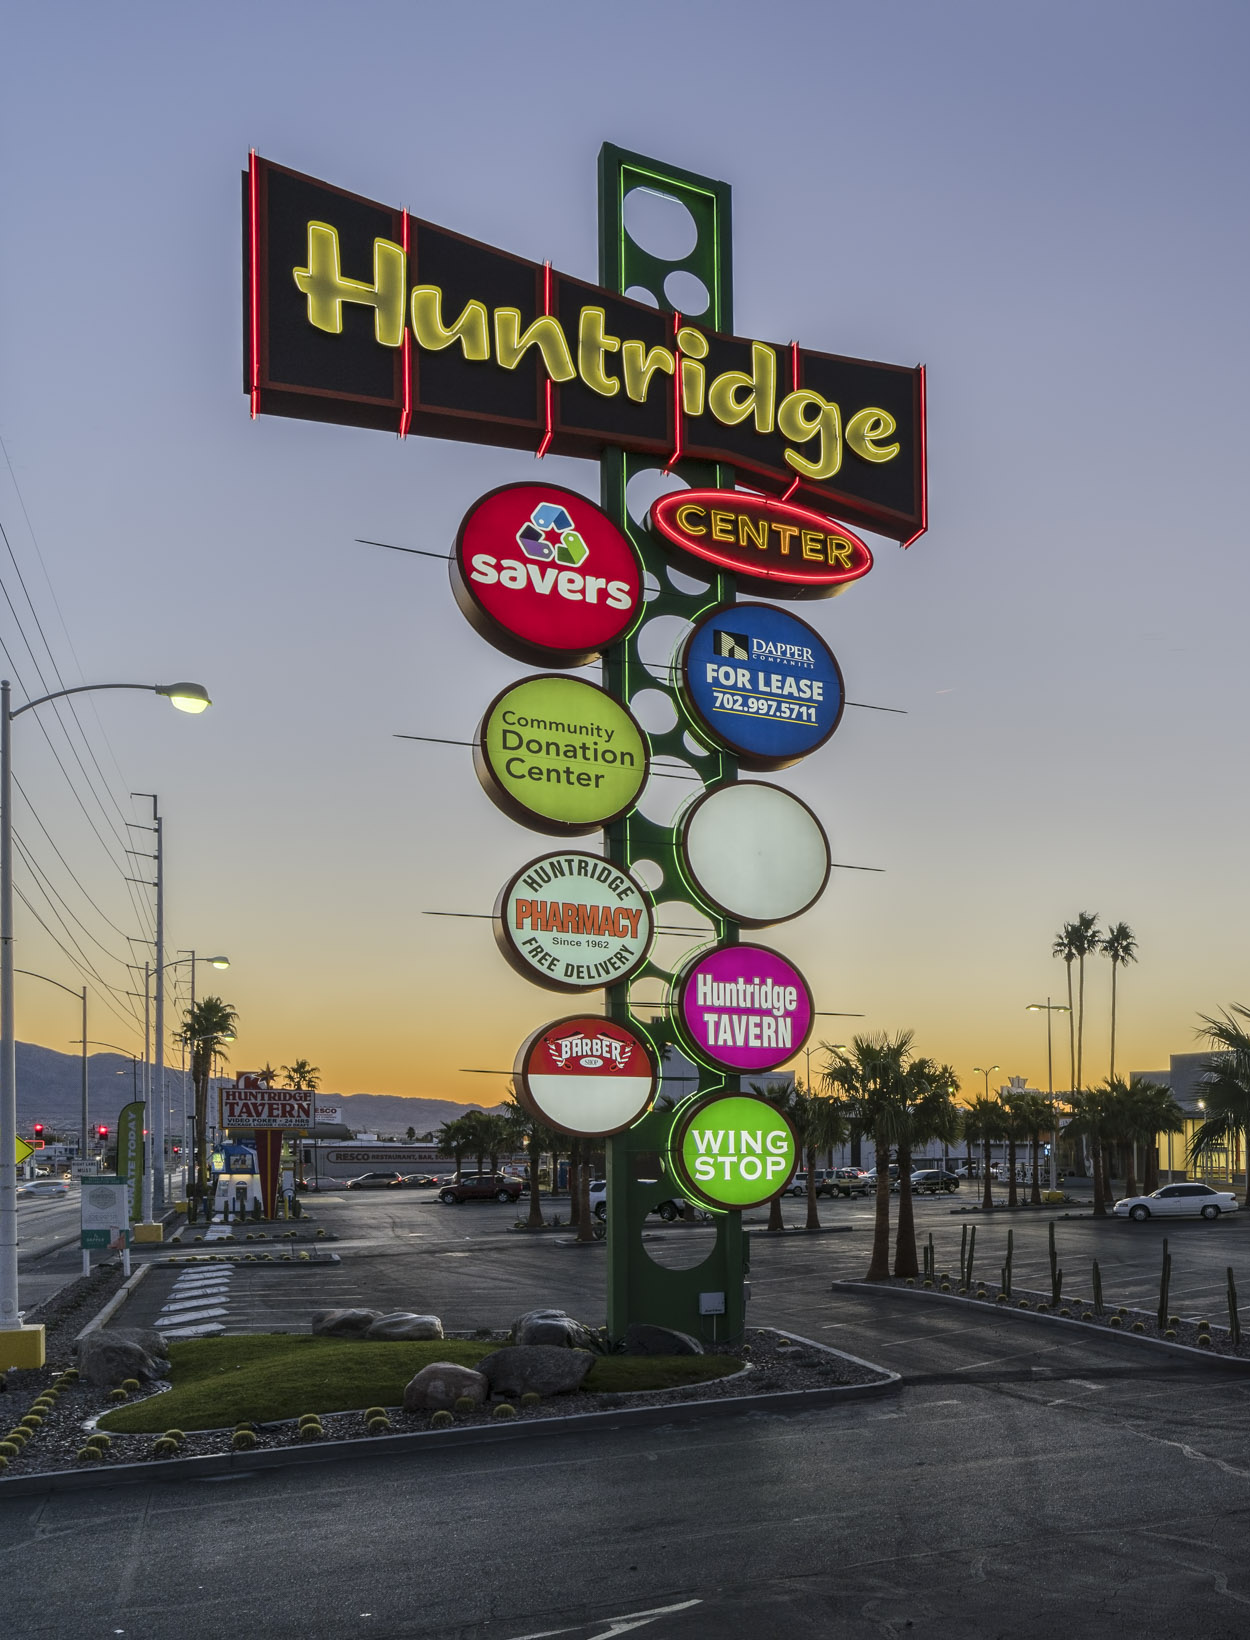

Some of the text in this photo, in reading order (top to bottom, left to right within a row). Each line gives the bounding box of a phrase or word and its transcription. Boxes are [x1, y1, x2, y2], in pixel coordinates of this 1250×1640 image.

[292, 220, 900, 480] Huntridge
[676, 504, 853, 569] CENTER
[470, 553, 632, 610] savers
[752, 638, 815, 662] DAPPER
[752, 654, 814, 669] COMPANIES
[706, 662, 824, 701] FOR LEASE
[713, 691, 816, 722] 702.997.5711
[502, 710, 615, 742] Community
[502, 729, 635, 767] Donation
[505, 757, 605, 789] Center
[522, 858, 635, 901] HUNTRIDGE
[515, 898, 643, 939] PHARMACY
[521, 936, 635, 979] FREE DELIVERY
[552, 937, 610, 949] Since 1962
[696, 973, 798, 1016] Huntridge
[703, 1013, 793, 1048] TAVERN
[561, 1038, 621, 1061] BARBER
[224, 1101, 311, 1119] TAVERN
[225, 1090, 312, 1102] HUNTRIDGE
[128, 1111, 137, 1157] TODAY
[691, 1129, 789, 1155] WING
[335, 1153, 370, 1161] RESCO
[694, 1156, 787, 1181] STOP
